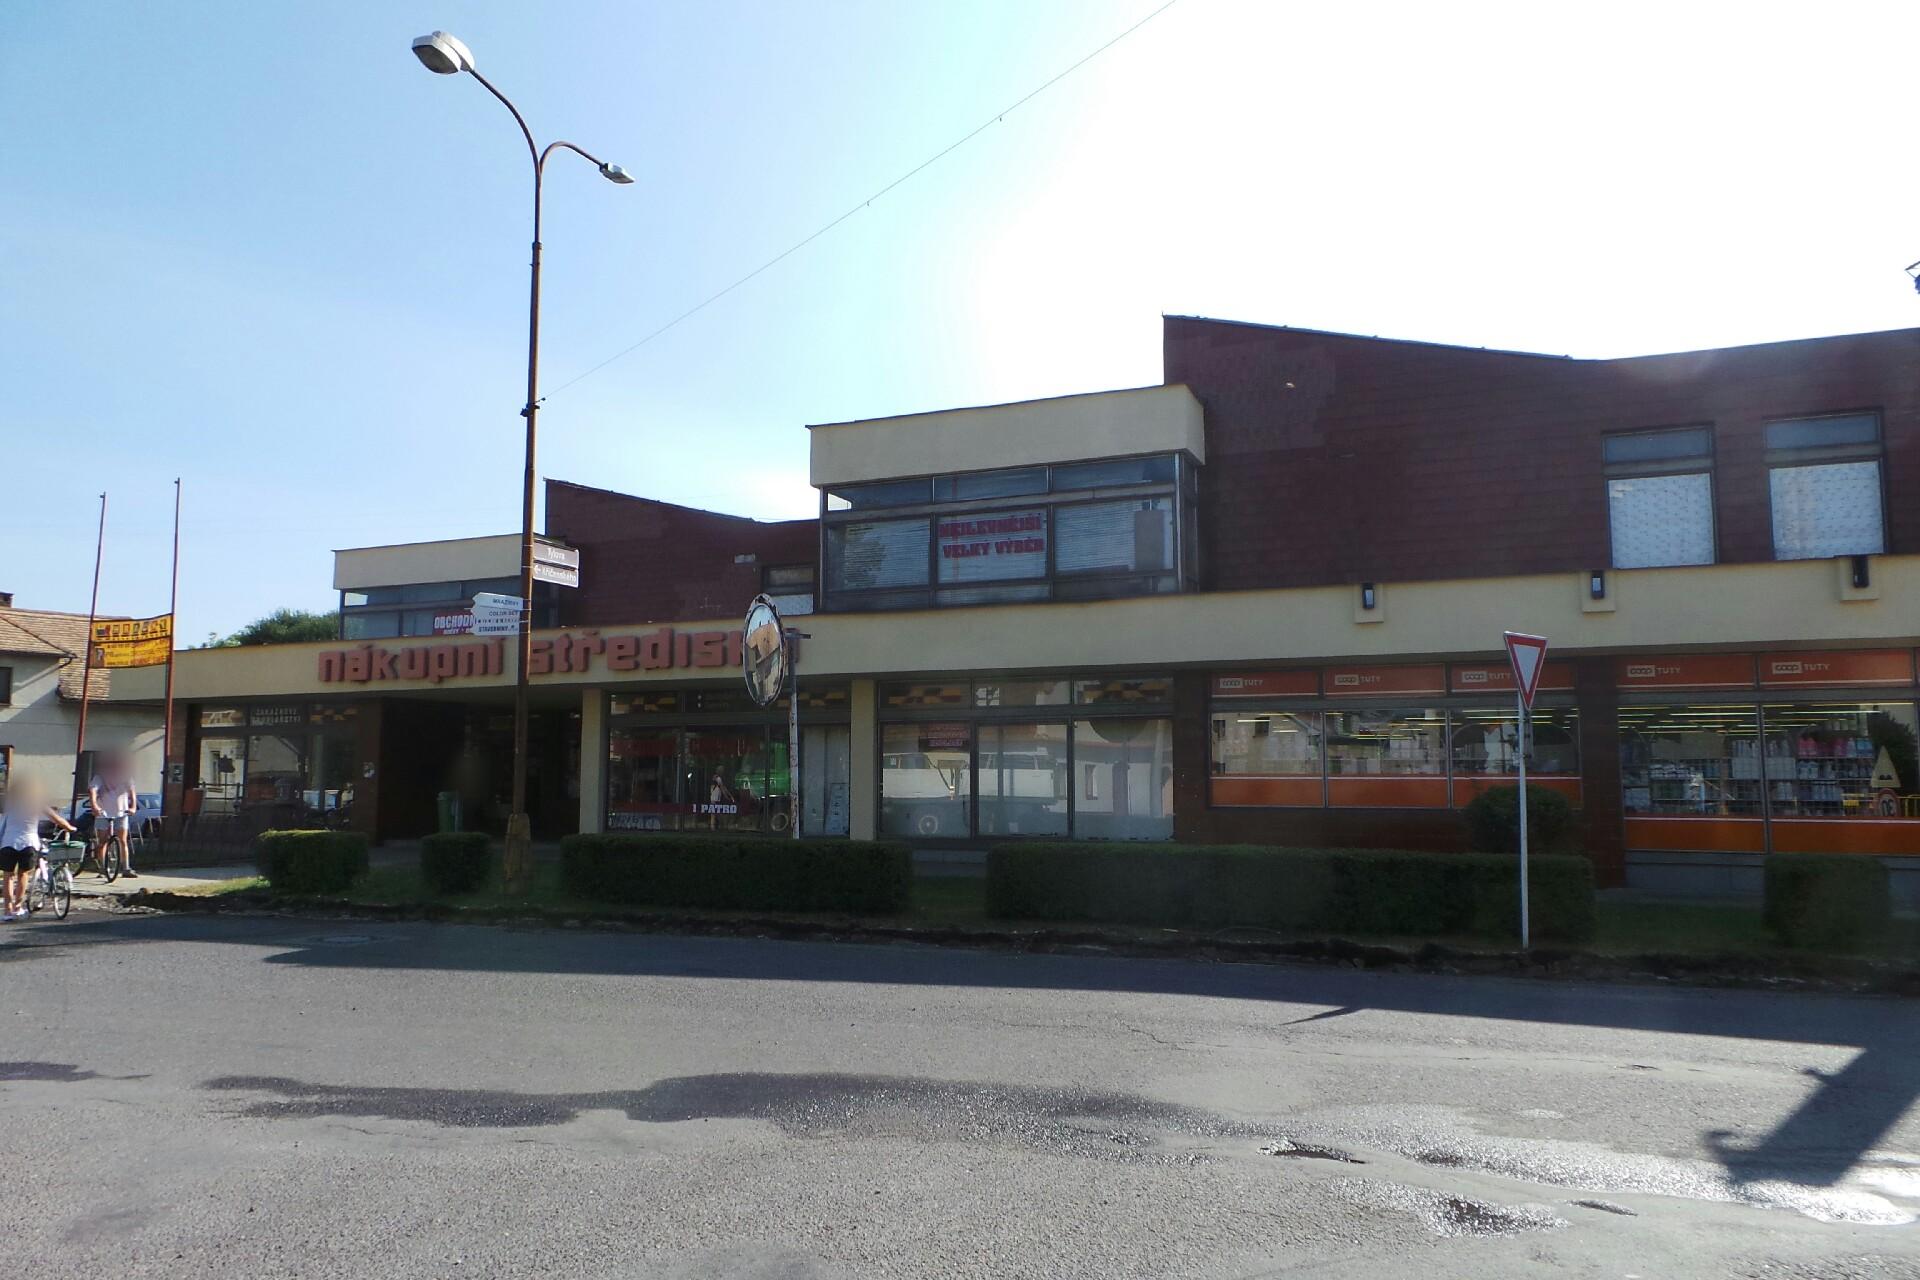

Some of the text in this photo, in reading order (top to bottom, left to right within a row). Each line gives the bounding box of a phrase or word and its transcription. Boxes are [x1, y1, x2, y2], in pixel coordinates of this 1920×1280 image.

[318, 627, 800, 683] nákupní středis
[1803, 663, 1831, 671] TUTY
[1360, 675, 1381, 684] TUTY
[1489, 672, 1512, 680] TUTY
[700, 803, 737, 814] PATRO
